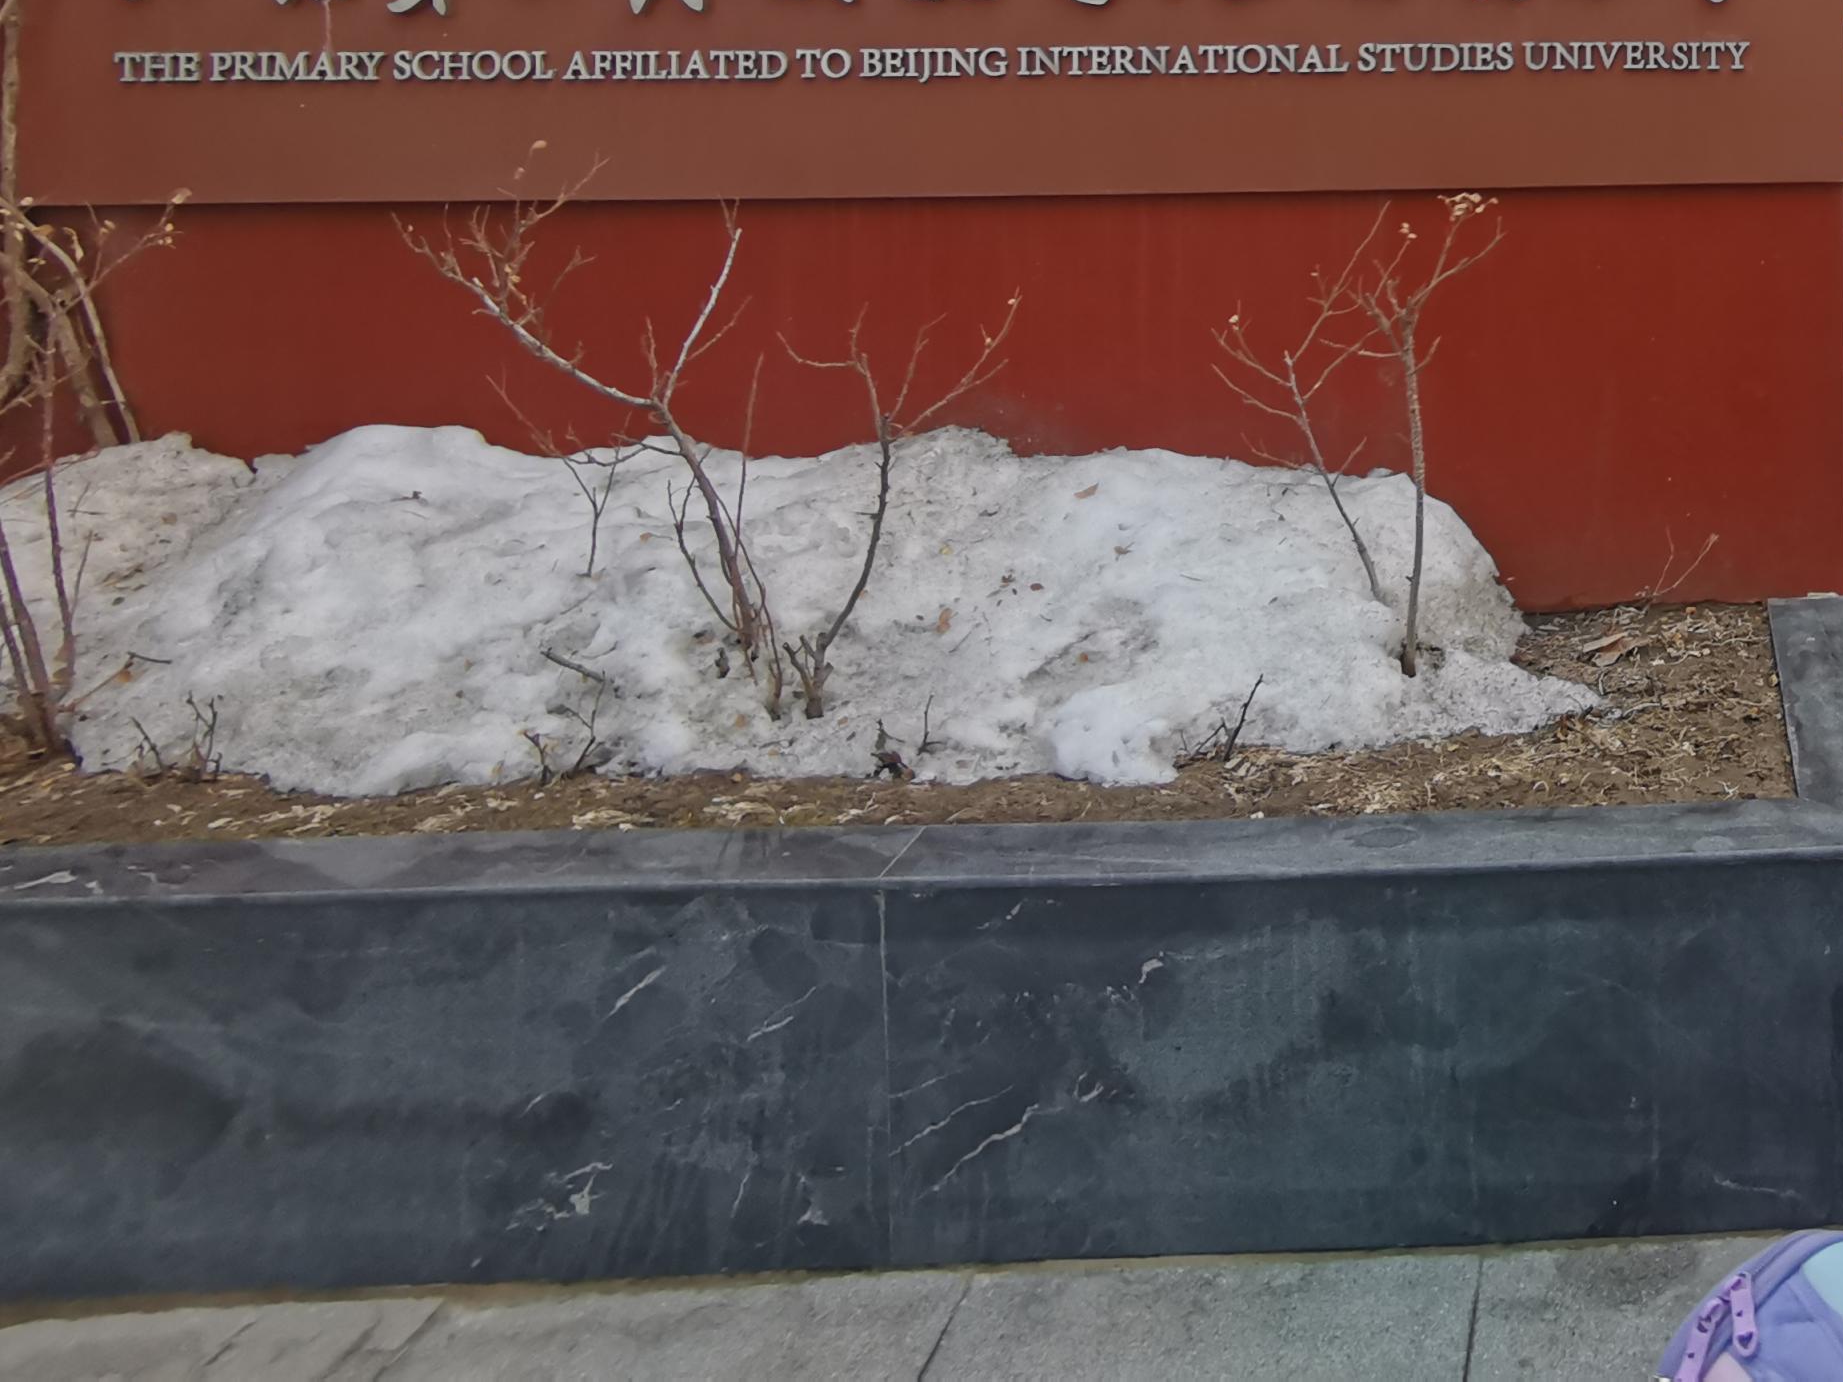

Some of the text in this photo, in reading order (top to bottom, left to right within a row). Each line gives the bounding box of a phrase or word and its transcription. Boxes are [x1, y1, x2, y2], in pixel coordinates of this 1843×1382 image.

[114, 40, 1750, 84] THE PRIMARY SCHOOL AFFILIATED TO BEIJING INTERNATIONAL STUDIES UNIVERSITY
